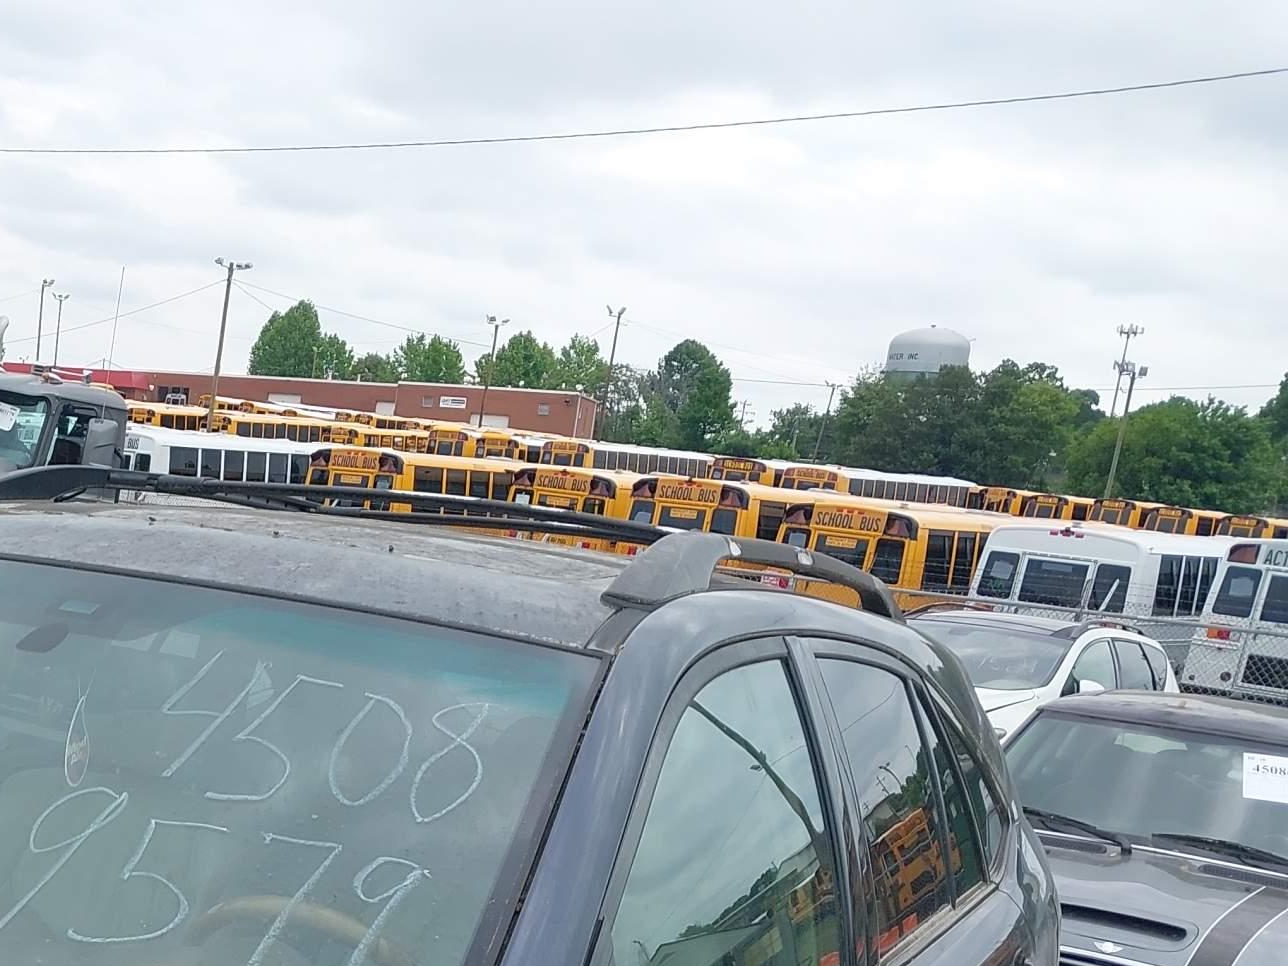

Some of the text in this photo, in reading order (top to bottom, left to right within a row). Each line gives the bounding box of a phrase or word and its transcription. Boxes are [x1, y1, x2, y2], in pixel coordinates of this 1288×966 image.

[332, 454, 378, 470] SCHOOL BUS
[537, 474, 588, 492] SCHOOL BUS
[659, 484, 717, 504] SCHOOL BUS
[815, 511, 882, 532] SCHOOL BUS
[162, 648, 489, 824] 4508
[1252, 763, 1288, 777] 4508
